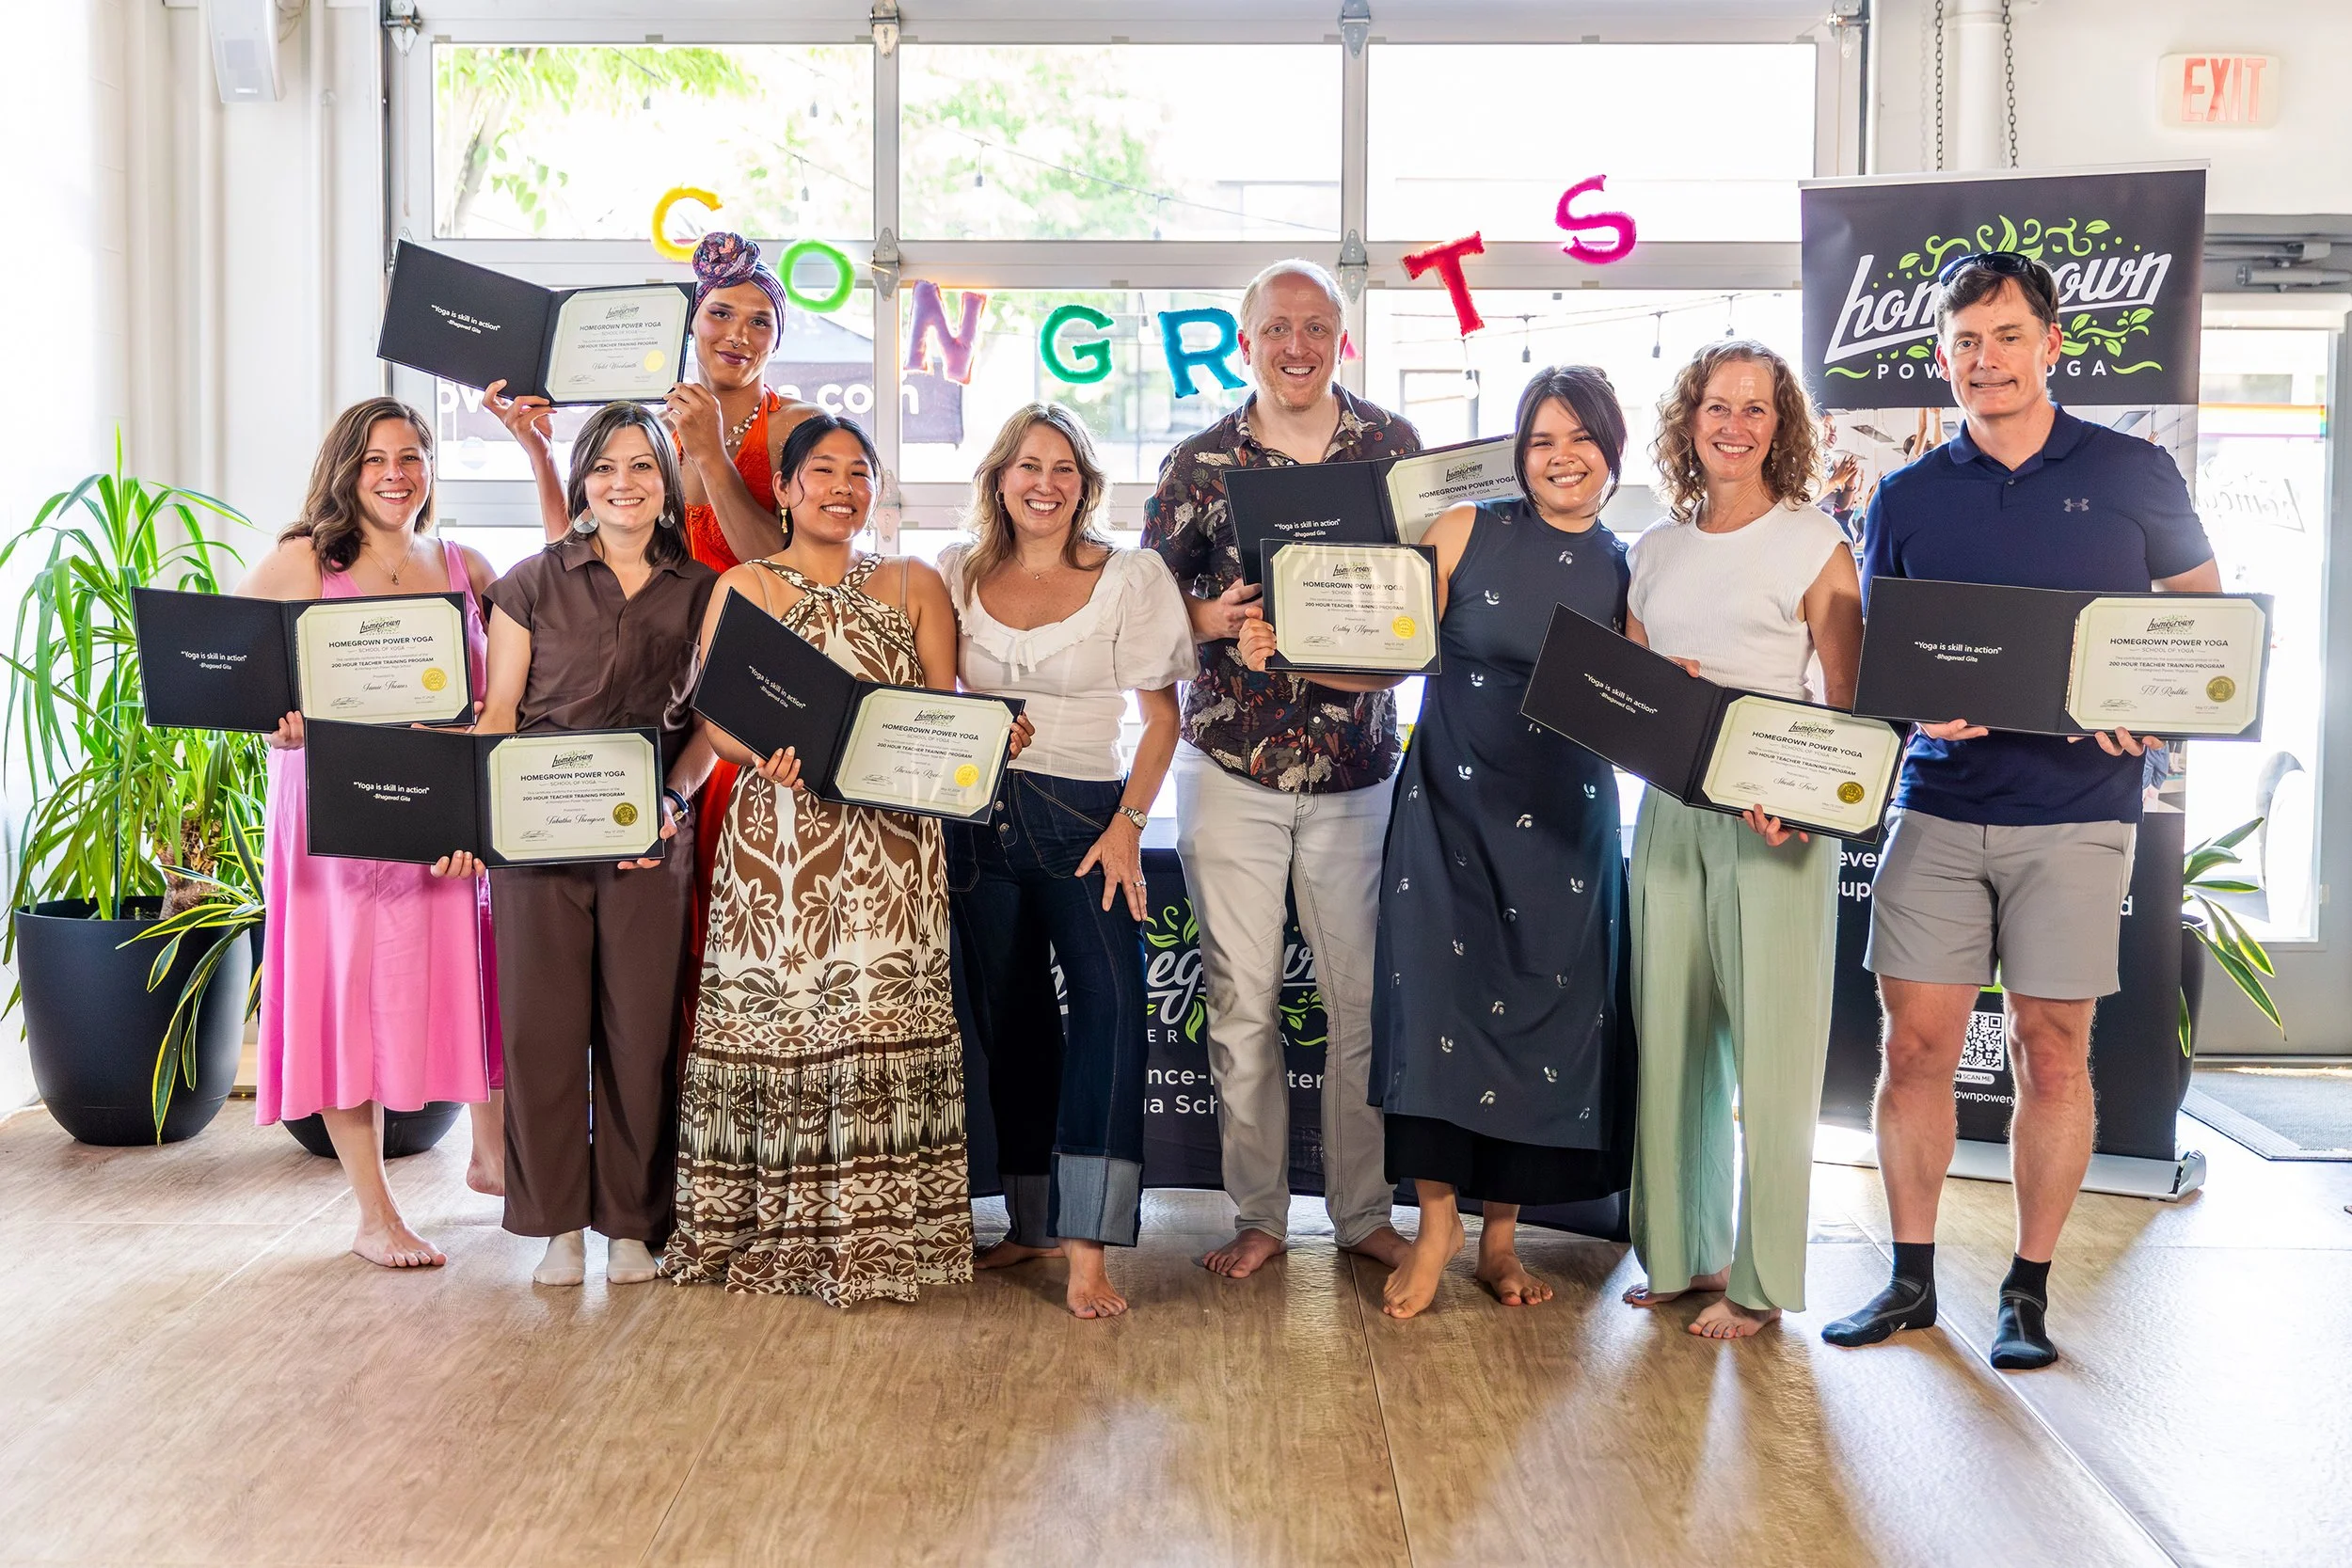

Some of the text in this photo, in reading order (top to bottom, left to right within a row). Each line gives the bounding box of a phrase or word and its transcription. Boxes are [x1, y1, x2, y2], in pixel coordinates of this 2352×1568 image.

[2182, 57, 2266, 122] EXIT
[651, 174, 1636, 400] CONGRTS
[1823, 251, 2172, 365] homown
[1877, 363, 1941, 380] POW
[1419, 476, 1515, 499] HOMEGROWN POWER YOGA
[360, 619, 400, 634] homegrown
[2147, 618, 2195, 632] homegrown
[770, 682, 781, 693] skill
[1612, 689, 1625, 699] skill
[914, 710, 955, 723] homegrown
[882, 723, 930, 735] HOMEGROWN
[931, 729, 957, 738] POWER
[1789, 721, 1835, 735] homegrown
[1752, 731, 1862, 758] HOMEGROWN POWER YOGA
[552, 754, 593, 767] homegrown
[1777, 756, 1801, 765] TEACHER
[1802, 761, 1827, 770] TRAINING
[1829, 766, 1856, 776] PROGRAM
[1953, 1090, 2016, 1107] ownpowery
